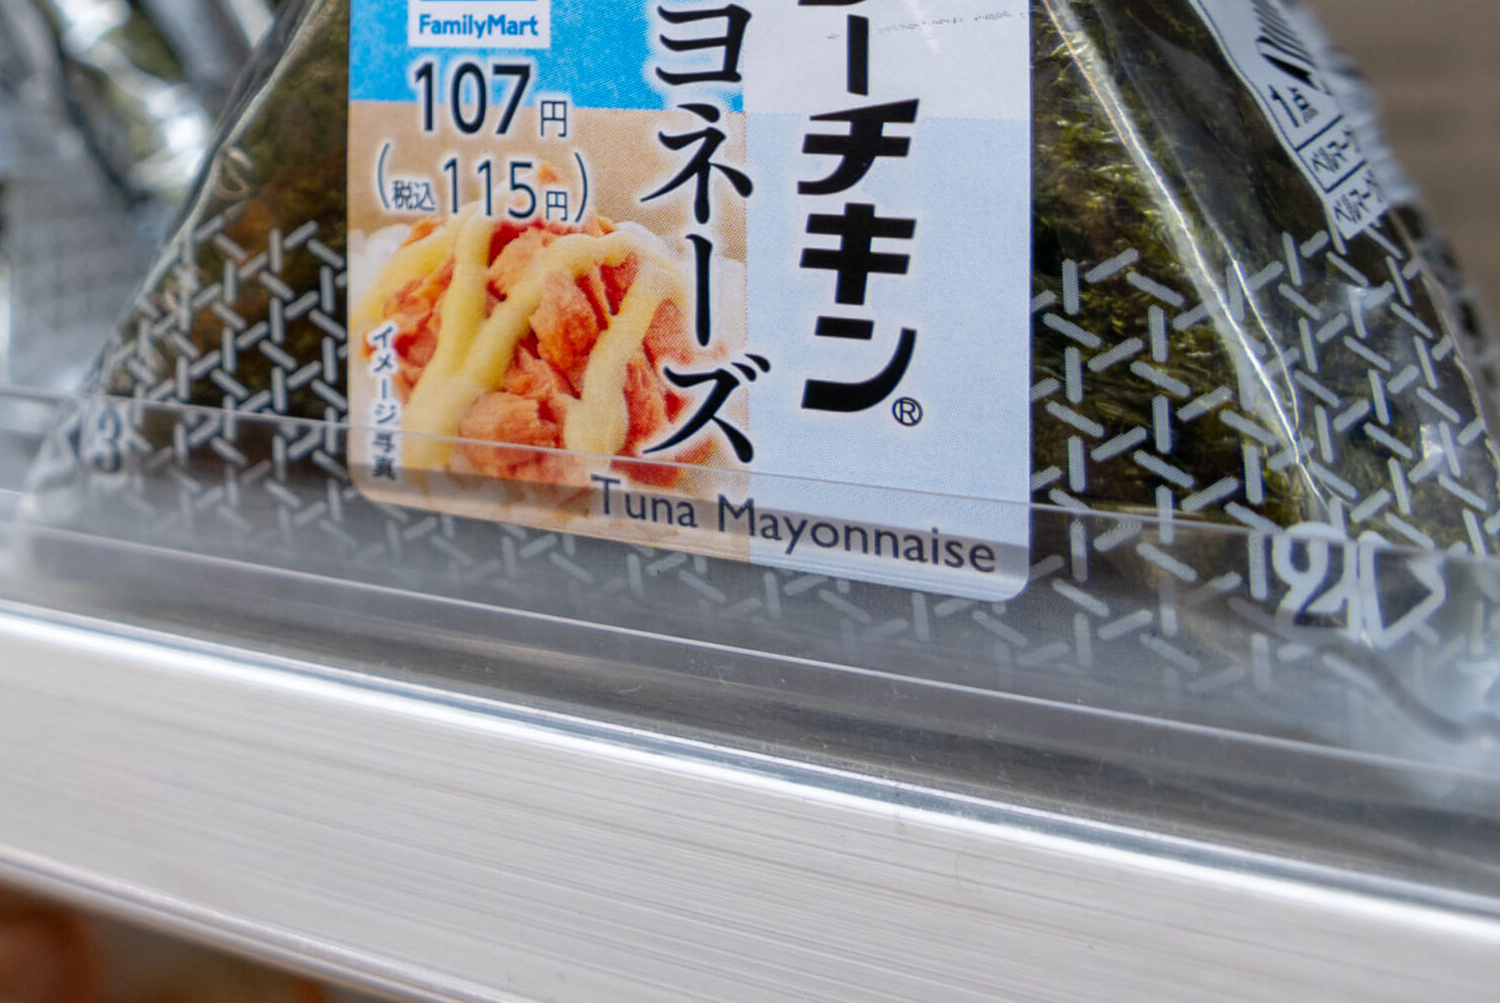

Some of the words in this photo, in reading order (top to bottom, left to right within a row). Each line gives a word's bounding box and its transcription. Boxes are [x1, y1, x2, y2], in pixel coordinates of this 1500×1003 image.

[418, 13, 540, 39] FamilyMart
[372, 325, 397, 482] イメージ写真
[589, 473, 699, 529] Tuna
[717, 494, 997, 575] Mayonnaise
